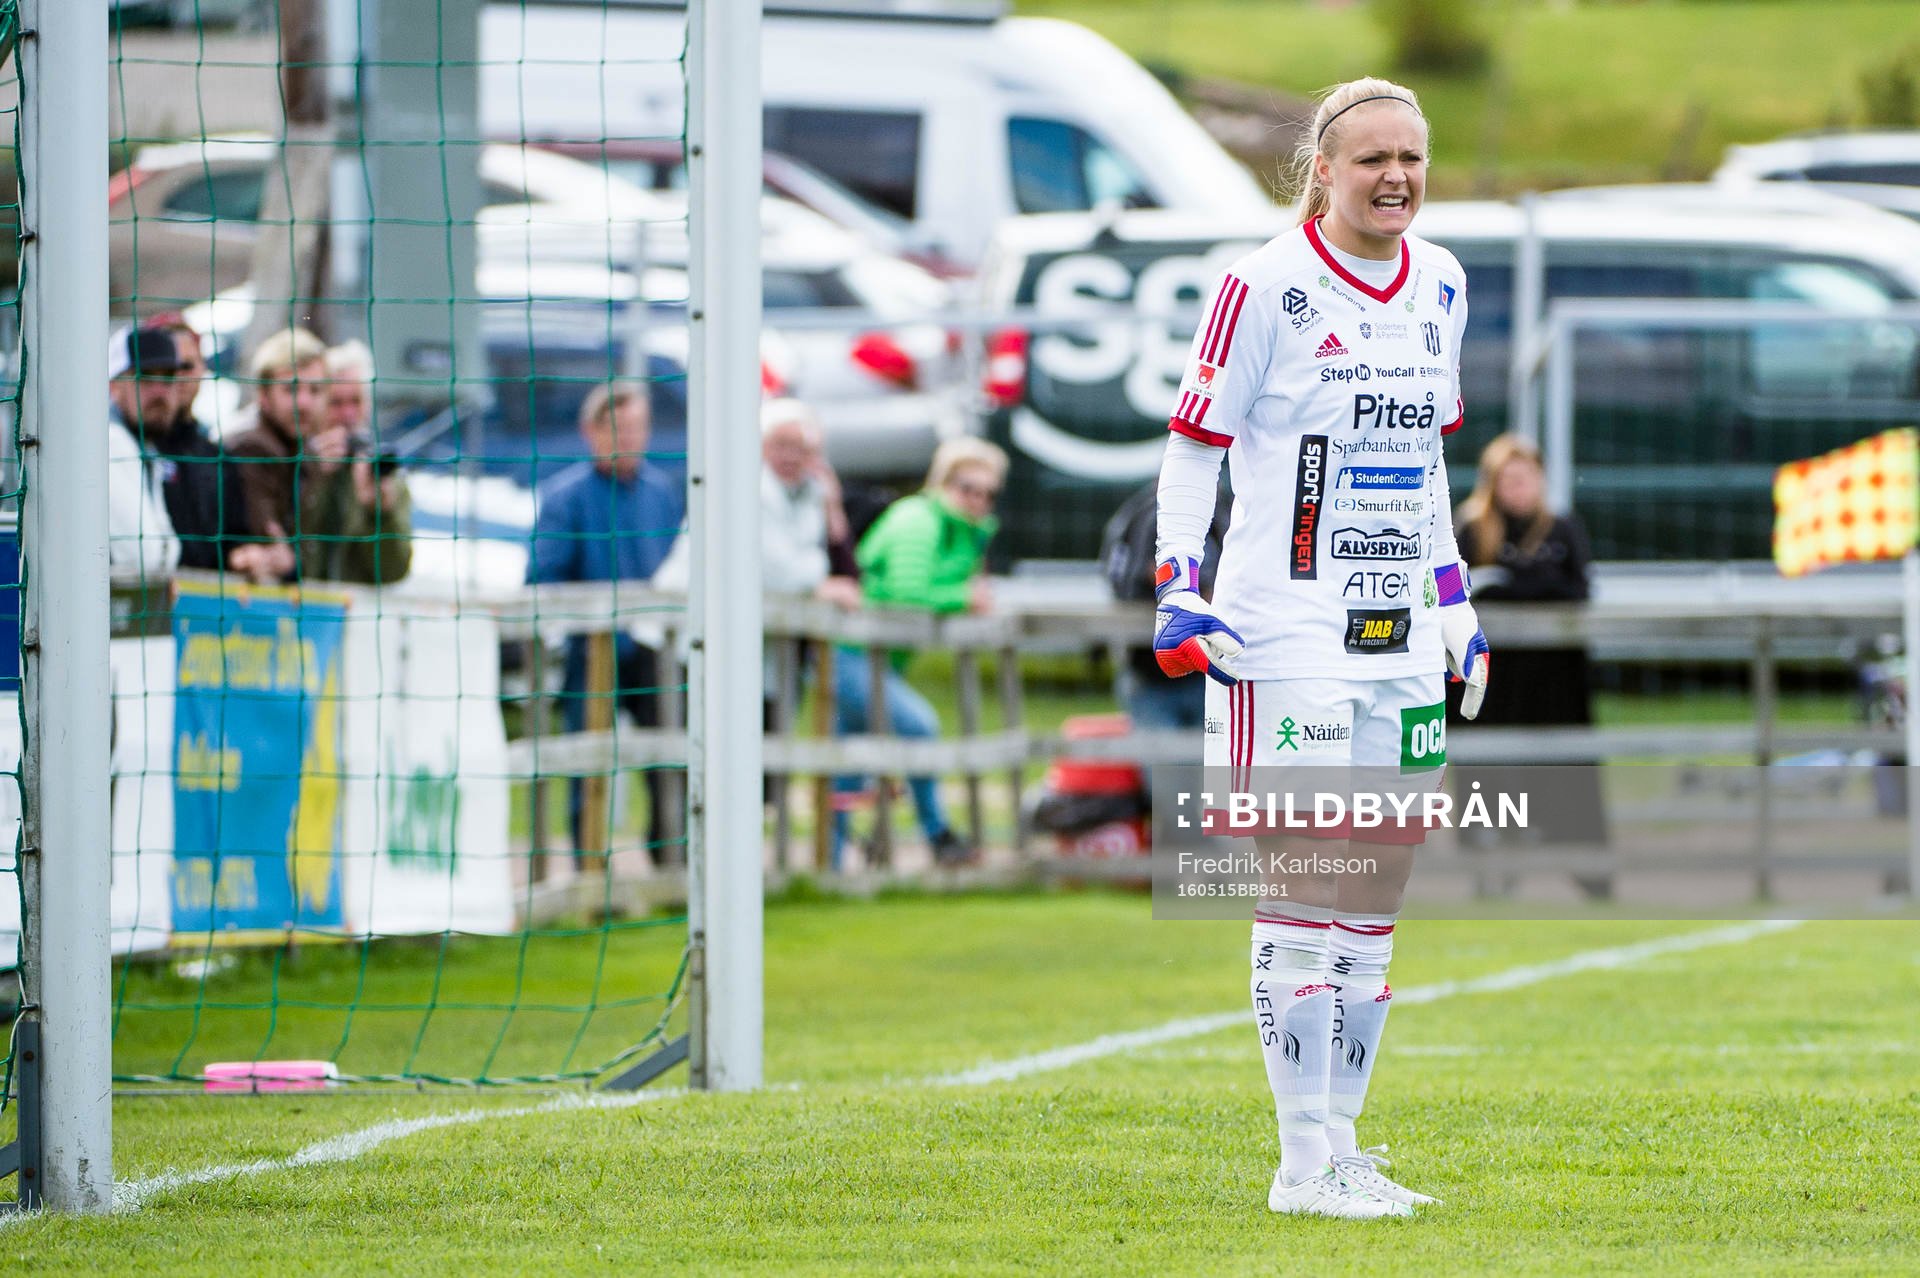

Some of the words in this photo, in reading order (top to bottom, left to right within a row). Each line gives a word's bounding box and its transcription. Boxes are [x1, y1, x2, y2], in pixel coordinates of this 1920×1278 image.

[1291, 307, 1320, 329] SCA
[1314, 347, 1349, 358] adidas
[1320, 367, 1353, 383] Step
[1375, 367, 1415, 378] YouCall
[1353, 391, 1435, 430] Piteå
[1331, 437, 1411, 459] Sparbanken
[1294, 443, 1322, 572] sportringen
[1357, 498, 1401, 512] Smurfit
[1337, 539, 1418, 556] ÄLVSBYHUS
[1342, 571, 1411, 599] ATEA
[1361, 620, 1394, 639] JIAB
